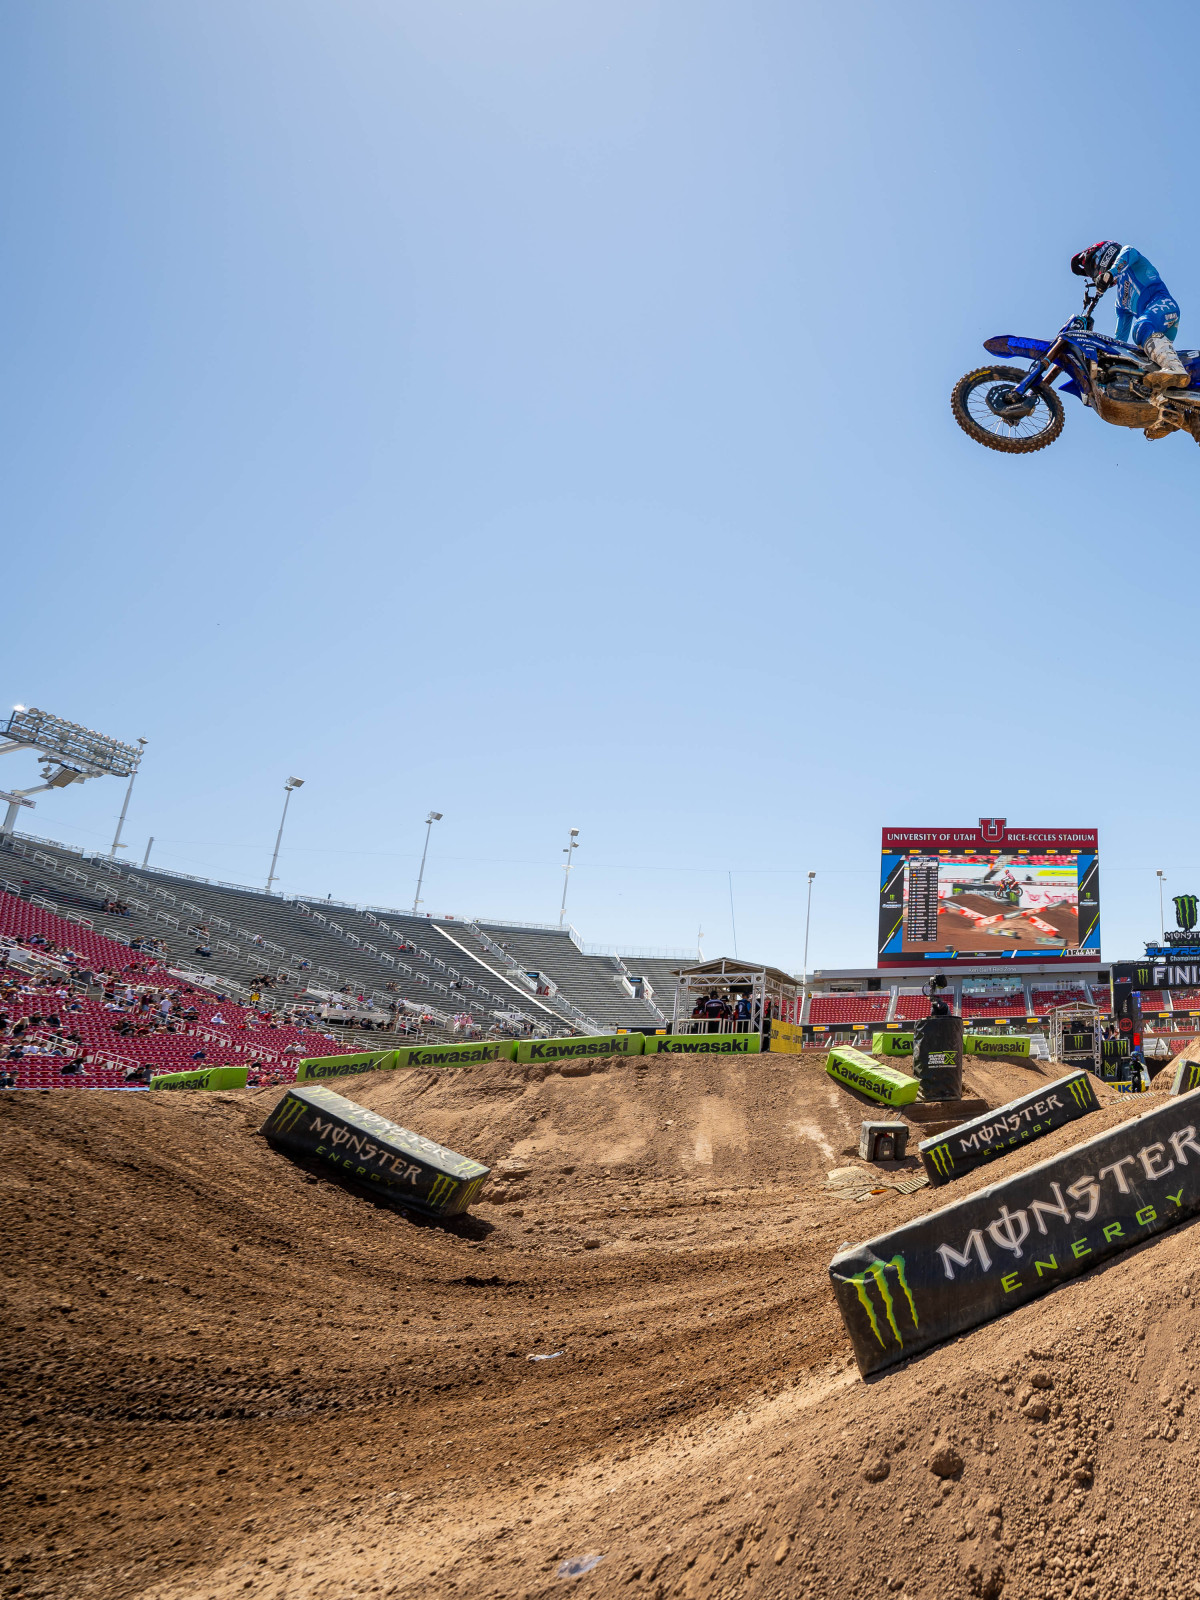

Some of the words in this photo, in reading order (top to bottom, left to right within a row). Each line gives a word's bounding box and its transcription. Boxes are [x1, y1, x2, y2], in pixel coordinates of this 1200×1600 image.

[887, 833, 937, 841] UNIVERSITY
[939, 833, 951, 841] OF
[954, 833, 976, 841] UTAH
[1008, 833, 1056, 841] RICE-ECCLES
[408, 1046, 500, 1065] Kawasaki
[530, 1038, 629, 1058] Kawasaki
[657, 1038, 749, 1053] Kawasaki
[974, 1040, 1025, 1053] Kawasaki
[305, 1059, 381, 1079] Kawasaki
[154, 1075, 210, 1090] Kawasaki
[832, 1059, 893, 1100] Kawasaki
[959, 1094, 1064, 1152] MONSTER
[983, 1118, 1053, 1155] ENERGY
[309, 1117, 422, 1184] MONSTER
[315, 1145, 395, 1187] ENERGY
[1000, 1188, 1184, 1293] ENERGY
